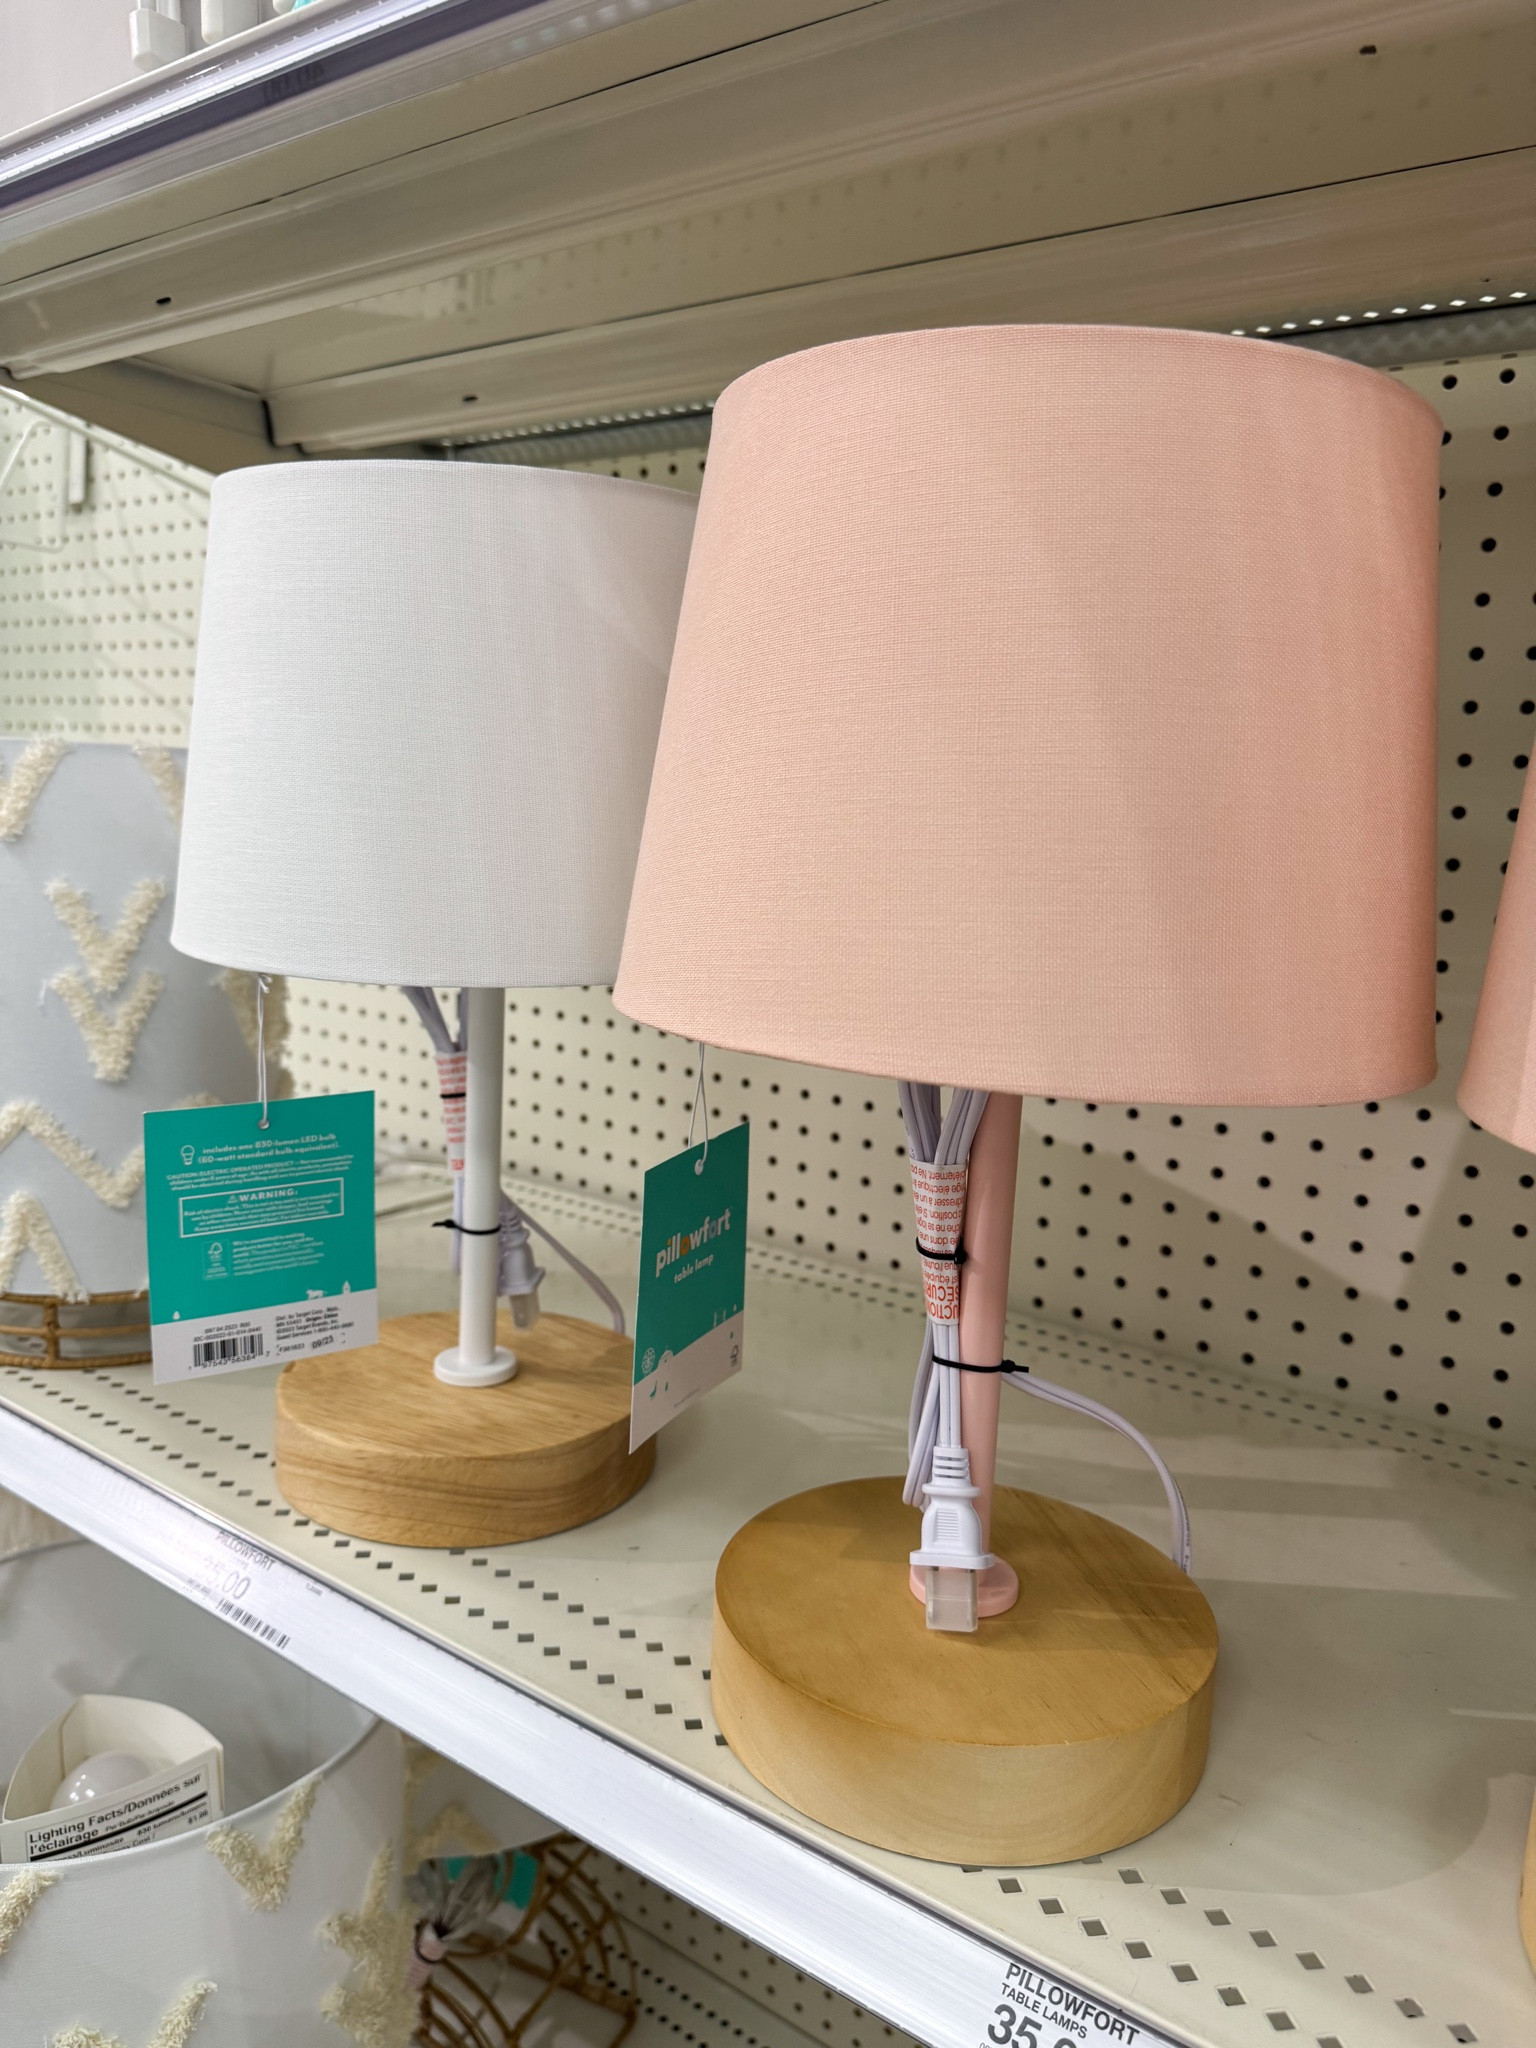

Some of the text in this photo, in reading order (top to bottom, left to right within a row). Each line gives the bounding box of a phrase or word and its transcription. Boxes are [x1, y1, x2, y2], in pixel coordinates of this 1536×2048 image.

[240, 1188, 298, 1202] WARNING:
[656, 1208, 731, 1278] pillowfort
[674, 1254, 714, 1284] table lamp
[216, 1530, 277, 1570] PILLOWFORT
[30, 1773, 202, 1844] Lighting Facts/Données sur
[30, 1829, 100, 1855] l'éclairage
[1000, 1982, 1088, 2040] TABLE LAMPS
[1005, 1962, 1140, 2046] PILLOWFORT
